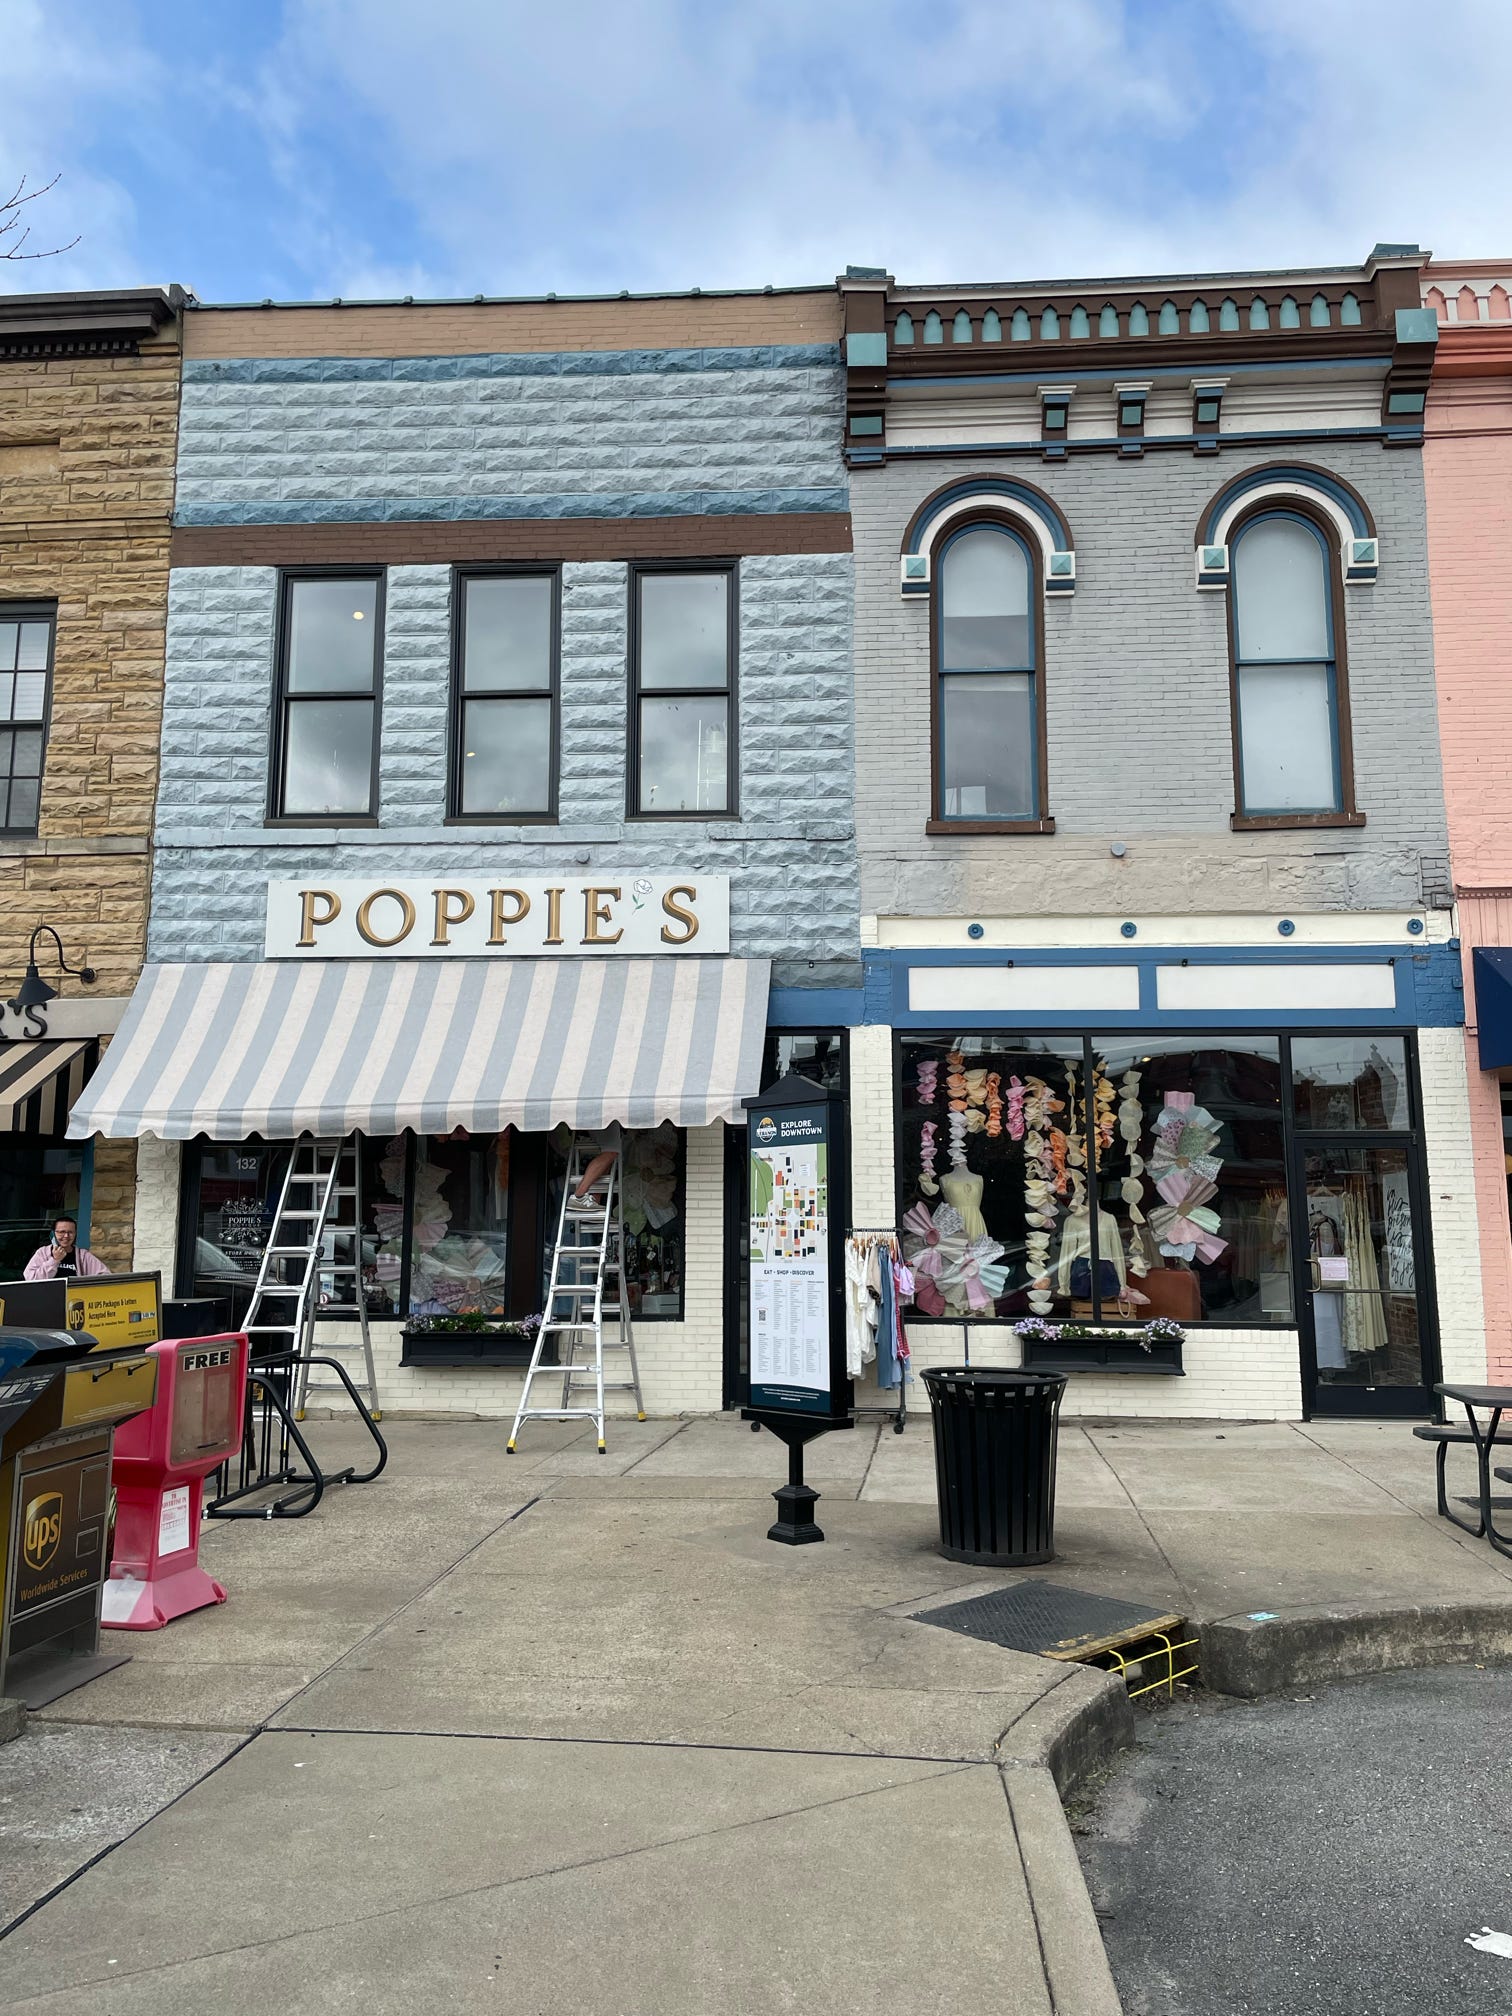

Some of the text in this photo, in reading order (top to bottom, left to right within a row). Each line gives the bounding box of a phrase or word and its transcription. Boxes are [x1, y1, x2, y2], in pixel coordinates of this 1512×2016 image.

[0, 999, 48, 1039] 'S
[781, 1119, 812, 1129] EXPLORE
[781, 1127, 823, 1137] DOWNTOWN
[236, 1158, 257, 1170] 132
[94, 1301, 102, 1309] UPS
[103, 1300, 120, 1308] Packages
[88, 1311, 106, 1320] Accepted
[184, 1351, 230, 1370] FREE
[27, 1513, 59, 1560] ups
[20, 1568, 88, 1602] Worldwide Services
